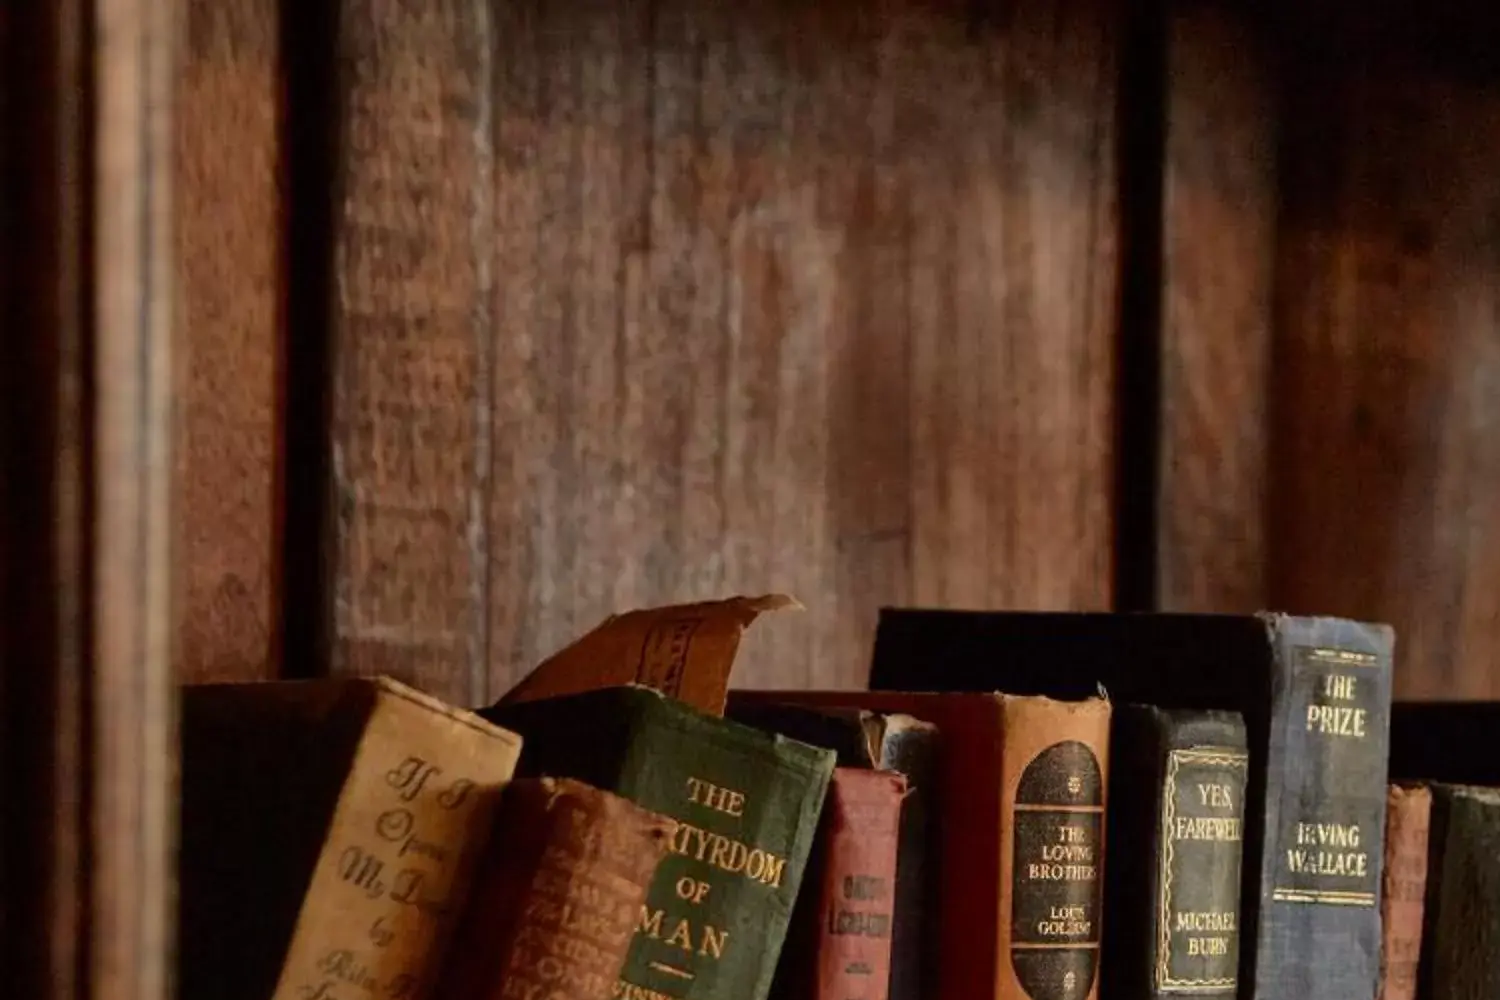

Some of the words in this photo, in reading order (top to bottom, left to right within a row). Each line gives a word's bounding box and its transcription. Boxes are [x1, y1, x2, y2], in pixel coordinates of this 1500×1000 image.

[1325, 674, 1358, 701] THE
[1306, 704, 1366, 738] PRIZE
[386, 756, 443, 803] If
[686, 776, 745, 818] THE
[1198, 783, 1234, 811] YES,
[1296, 820, 1360, 848] IRVING
[663, 821, 787, 889] RTYRDOM
[1286, 848, 1368, 878] WALLACE
[675, 877, 712, 905] OF
[638, 903, 730, 959] MAN
[1176, 911, 1237, 933] MICHAEL
[1187, 936, 1230, 957] BURN
